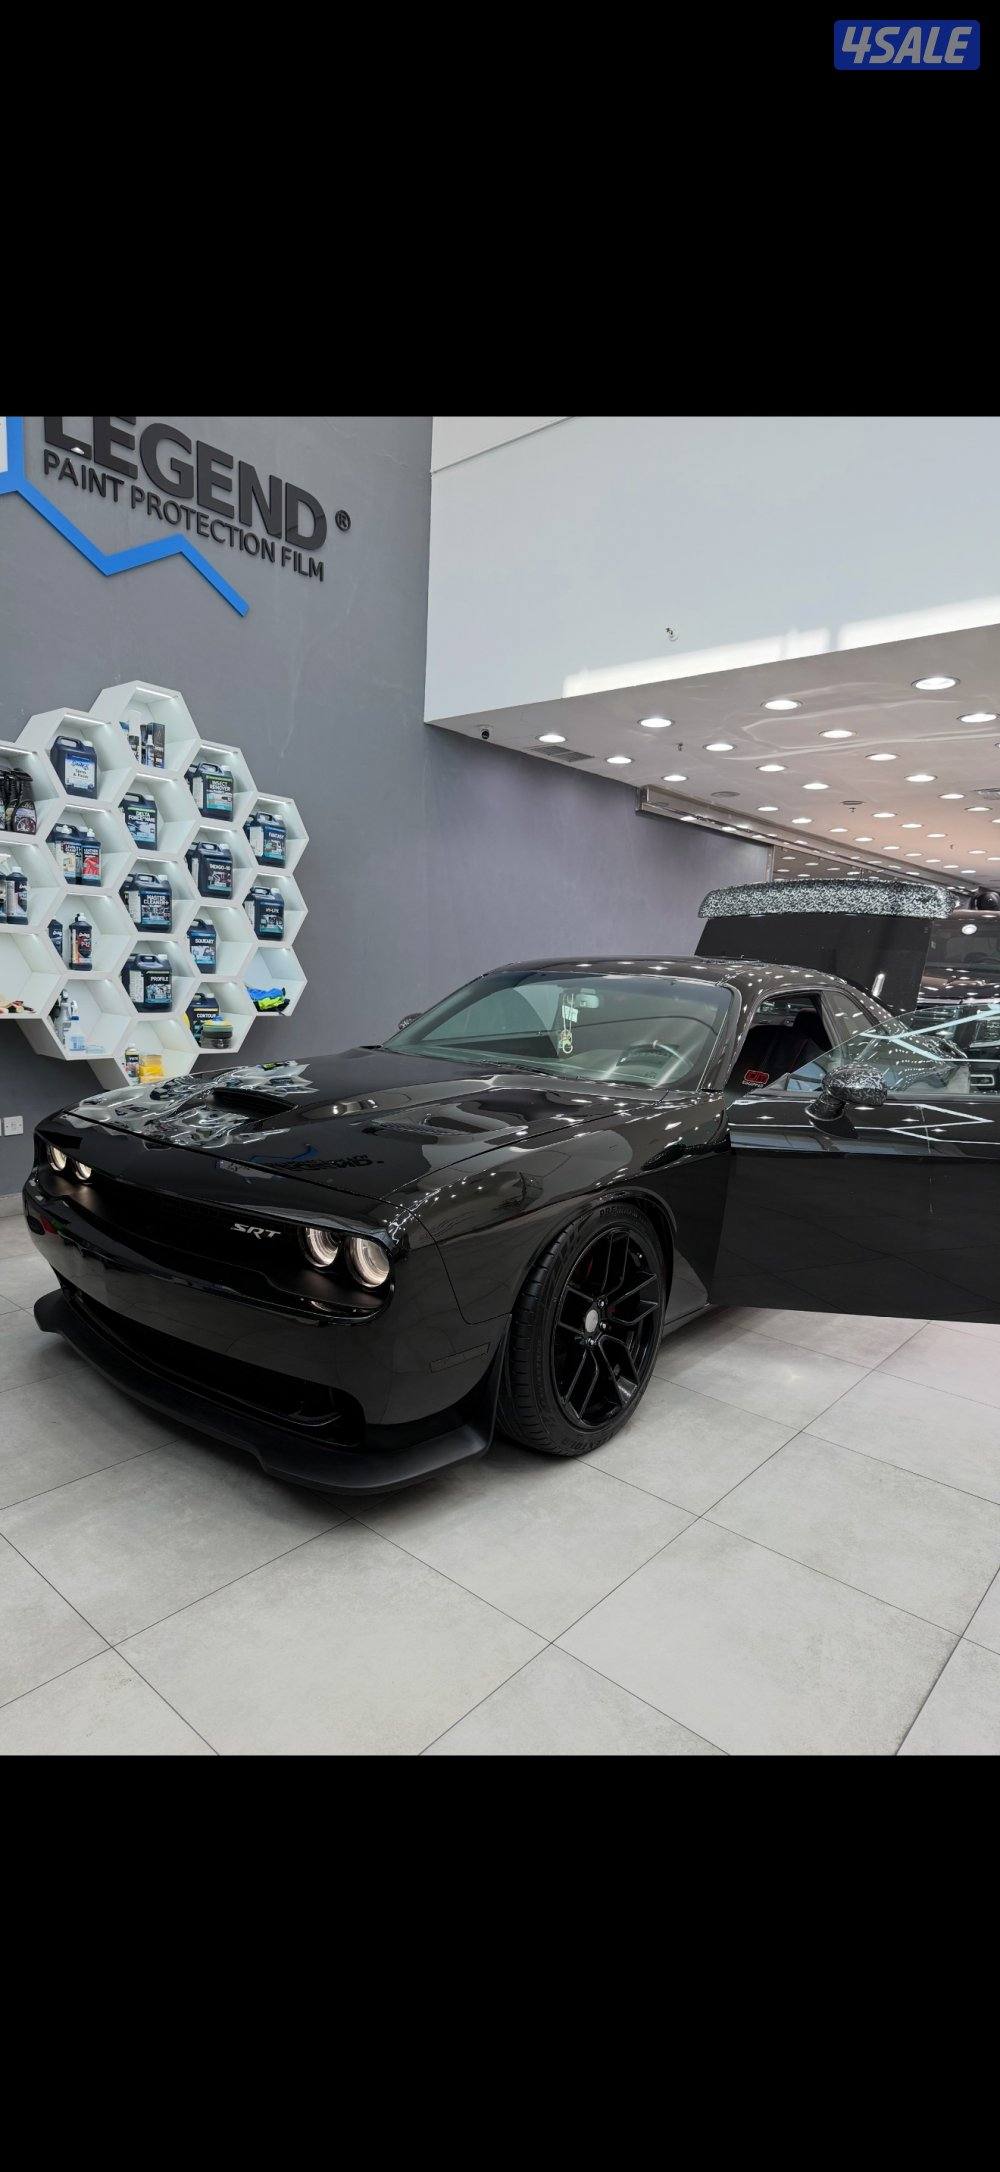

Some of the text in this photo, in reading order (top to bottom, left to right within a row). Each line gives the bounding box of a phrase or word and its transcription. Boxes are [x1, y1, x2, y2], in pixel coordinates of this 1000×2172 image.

[43, 448, 324, 582] PAINT PROTECTION FILM
[45, 416, 327, 551] LEGEND
[230, 1223, 281, 1240] SRT
